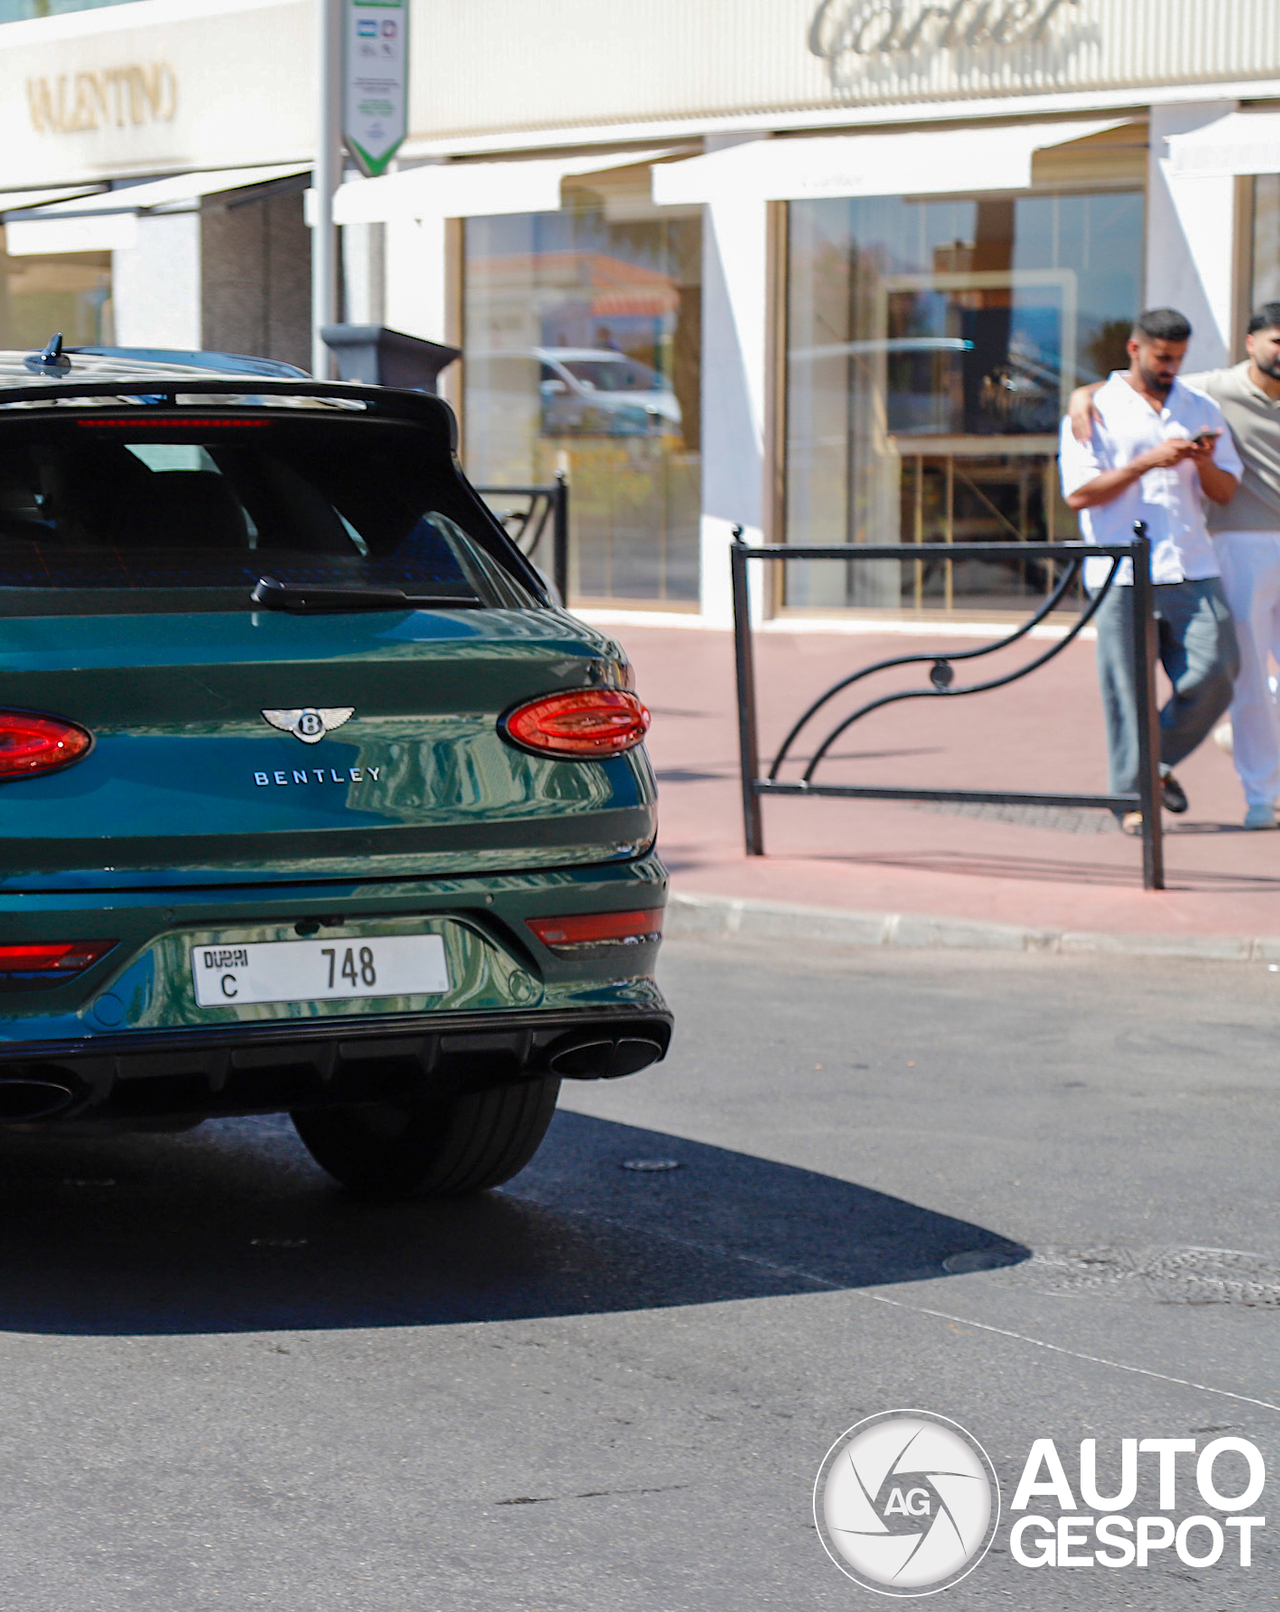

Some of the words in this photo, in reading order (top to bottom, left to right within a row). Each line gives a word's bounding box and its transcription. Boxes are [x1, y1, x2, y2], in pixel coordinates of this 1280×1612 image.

[25, 60, 178, 134] VALENTINO
[253, 766, 380, 786] BENTLEY
[320, 946, 377, 989] 748
[221, 974, 238, 998] C
